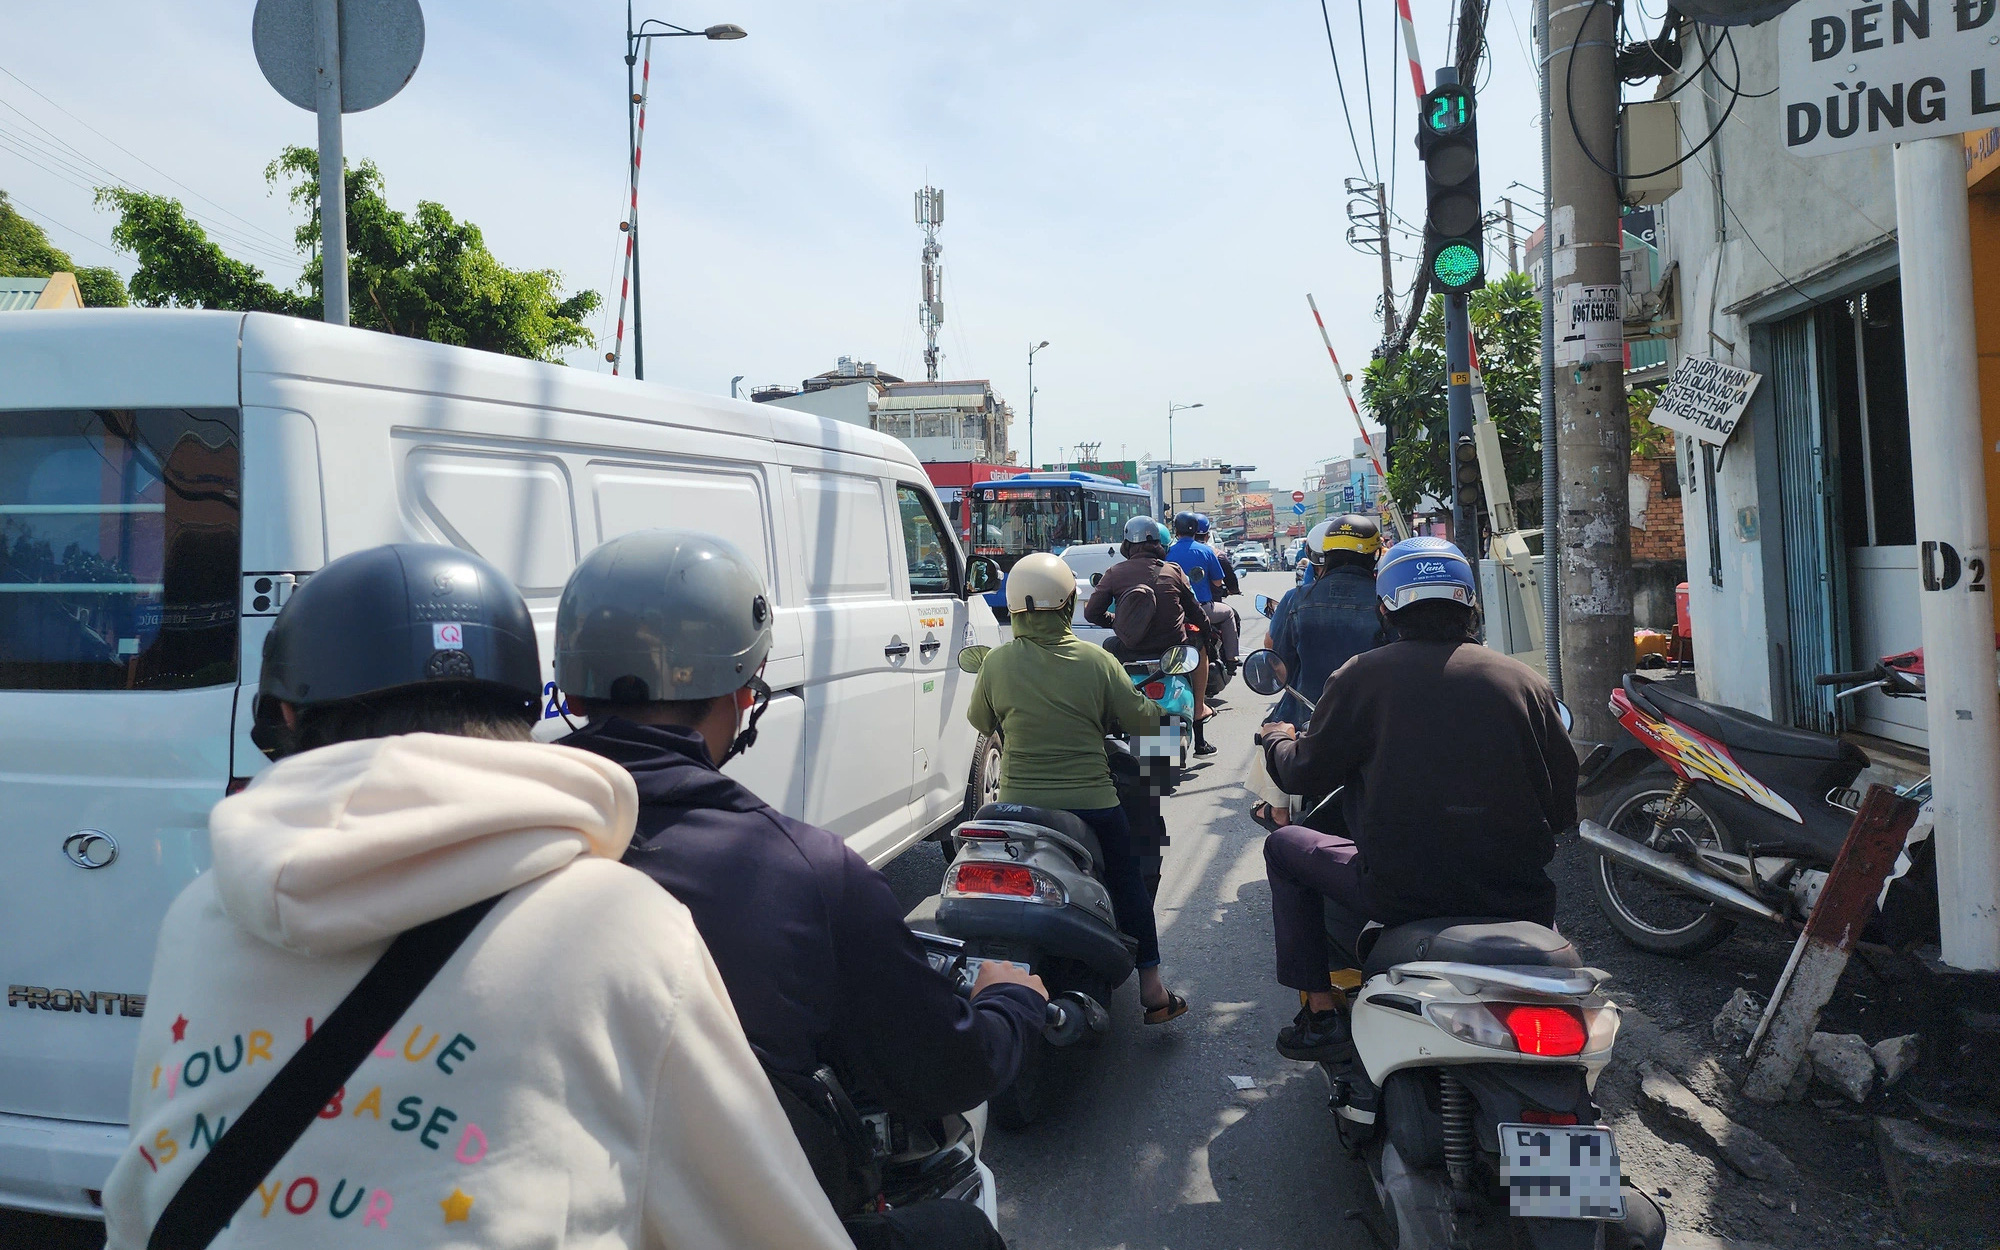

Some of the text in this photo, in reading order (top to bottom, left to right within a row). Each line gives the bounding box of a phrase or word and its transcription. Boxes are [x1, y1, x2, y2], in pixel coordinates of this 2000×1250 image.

[1432, 96, 1465, 129] 21
[1787, 76, 1946, 147] DỪNG
[1456, 374, 1467, 383] P5
[984, 490, 994, 500] 29
[258, 1177, 394, 1230] YOUR
